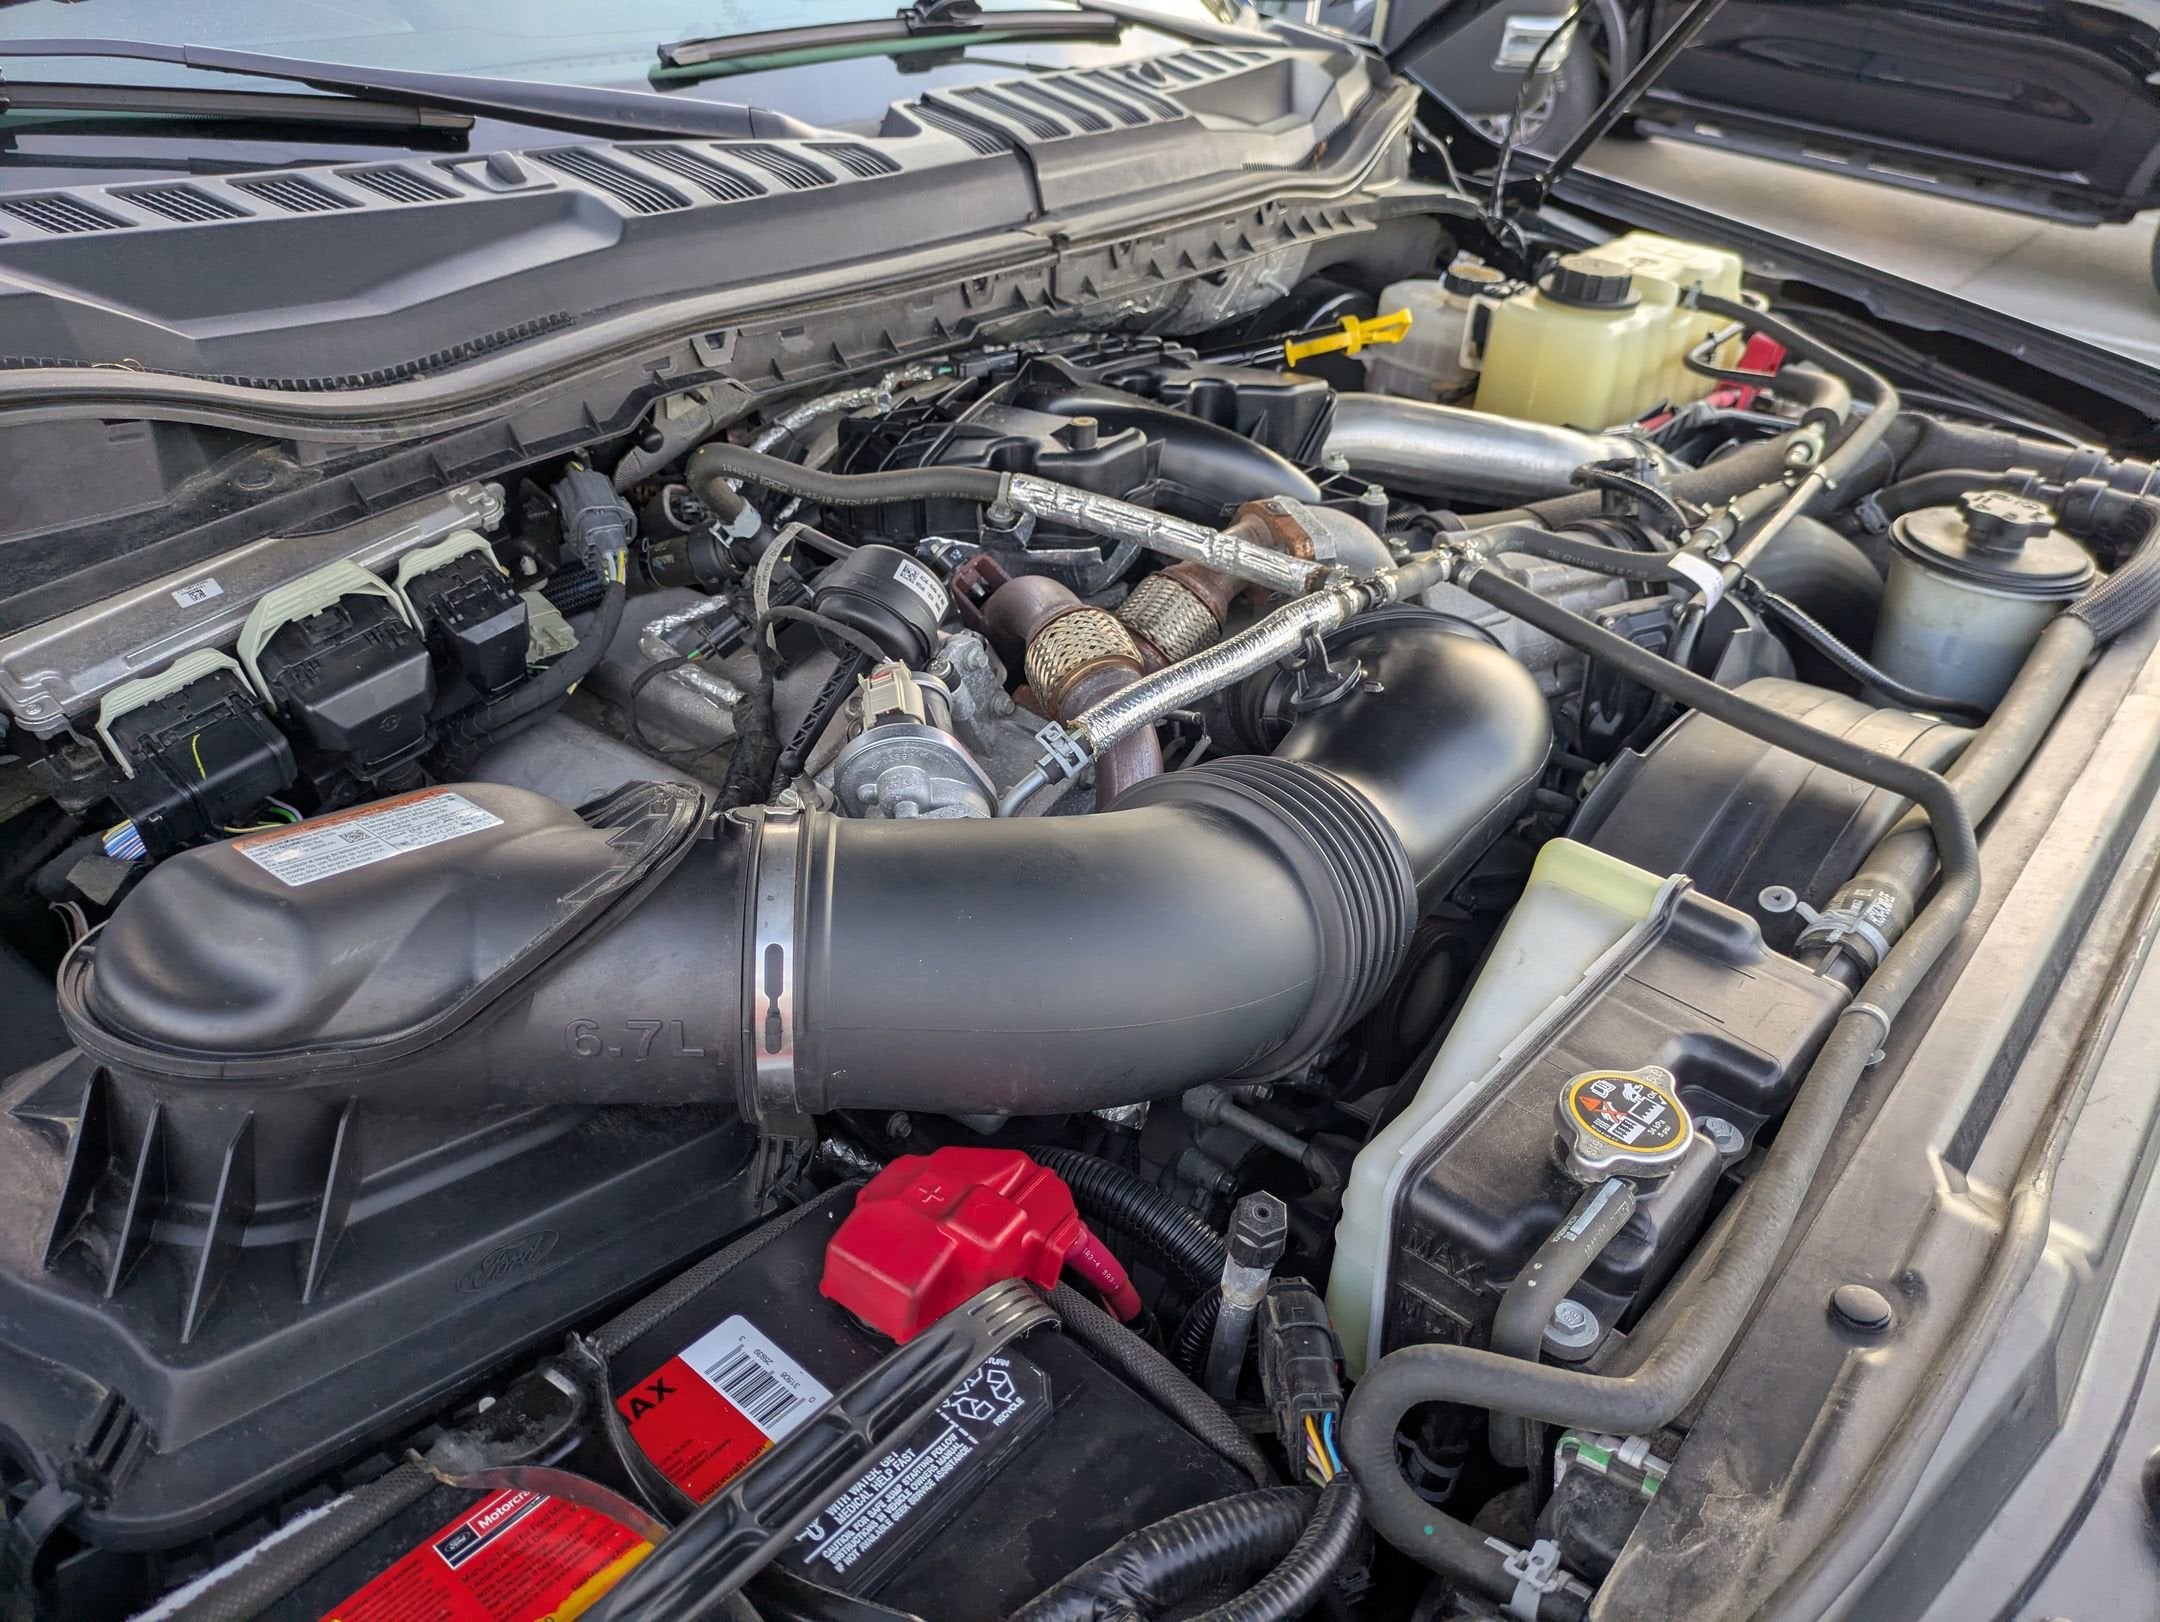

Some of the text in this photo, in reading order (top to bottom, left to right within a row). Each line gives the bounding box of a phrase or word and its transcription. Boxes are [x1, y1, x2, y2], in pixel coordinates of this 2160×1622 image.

[564, 1017, 705, 1060] 6.7L
[1647, 1091, 1658, 1100] OK
[1647, 1119, 1666, 1136] 34 kPa
[1663, 1126, 1672, 1135] psi
[466, 1234, 548, 1290] Ford
[1404, 1223, 1485, 1294] MAX
[779, 1371, 801, 1390] 31508
[992, 1396, 1025, 1426] RECYCLE
[826, 1490, 851, 1516] WITH
[880, 1451, 899, 1468] GET
[833, 1448, 917, 1526] MEDICAL HELP FAST
[852, 1515, 869, 1531] FOR
[865, 1498, 887, 1518] SAFE
[883, 1482, 904, 1502] JUMP
[900, 1454, 934, 1486] STARTING
[930, 1432, 958, 1458] FOLLOW
[477, 1488, 531, 1530] Motorcra
[829, 1518, 879, 1565] INSTRUCTIONS
[875, 1510, 887, 1523] IN
[883, 1487, 913, 1515] VEHICLE
[911, 1462, 939, 1490] OWNERS
[834, 1559, 846, 1573] IF
[844, 1548, 861, 1565] NOT
[859, 1517, 896, 1552] AVAILABLE
[893, 1501, 911, 1520] SEEK
[910, 1477, 936, 1505] SERVICE
